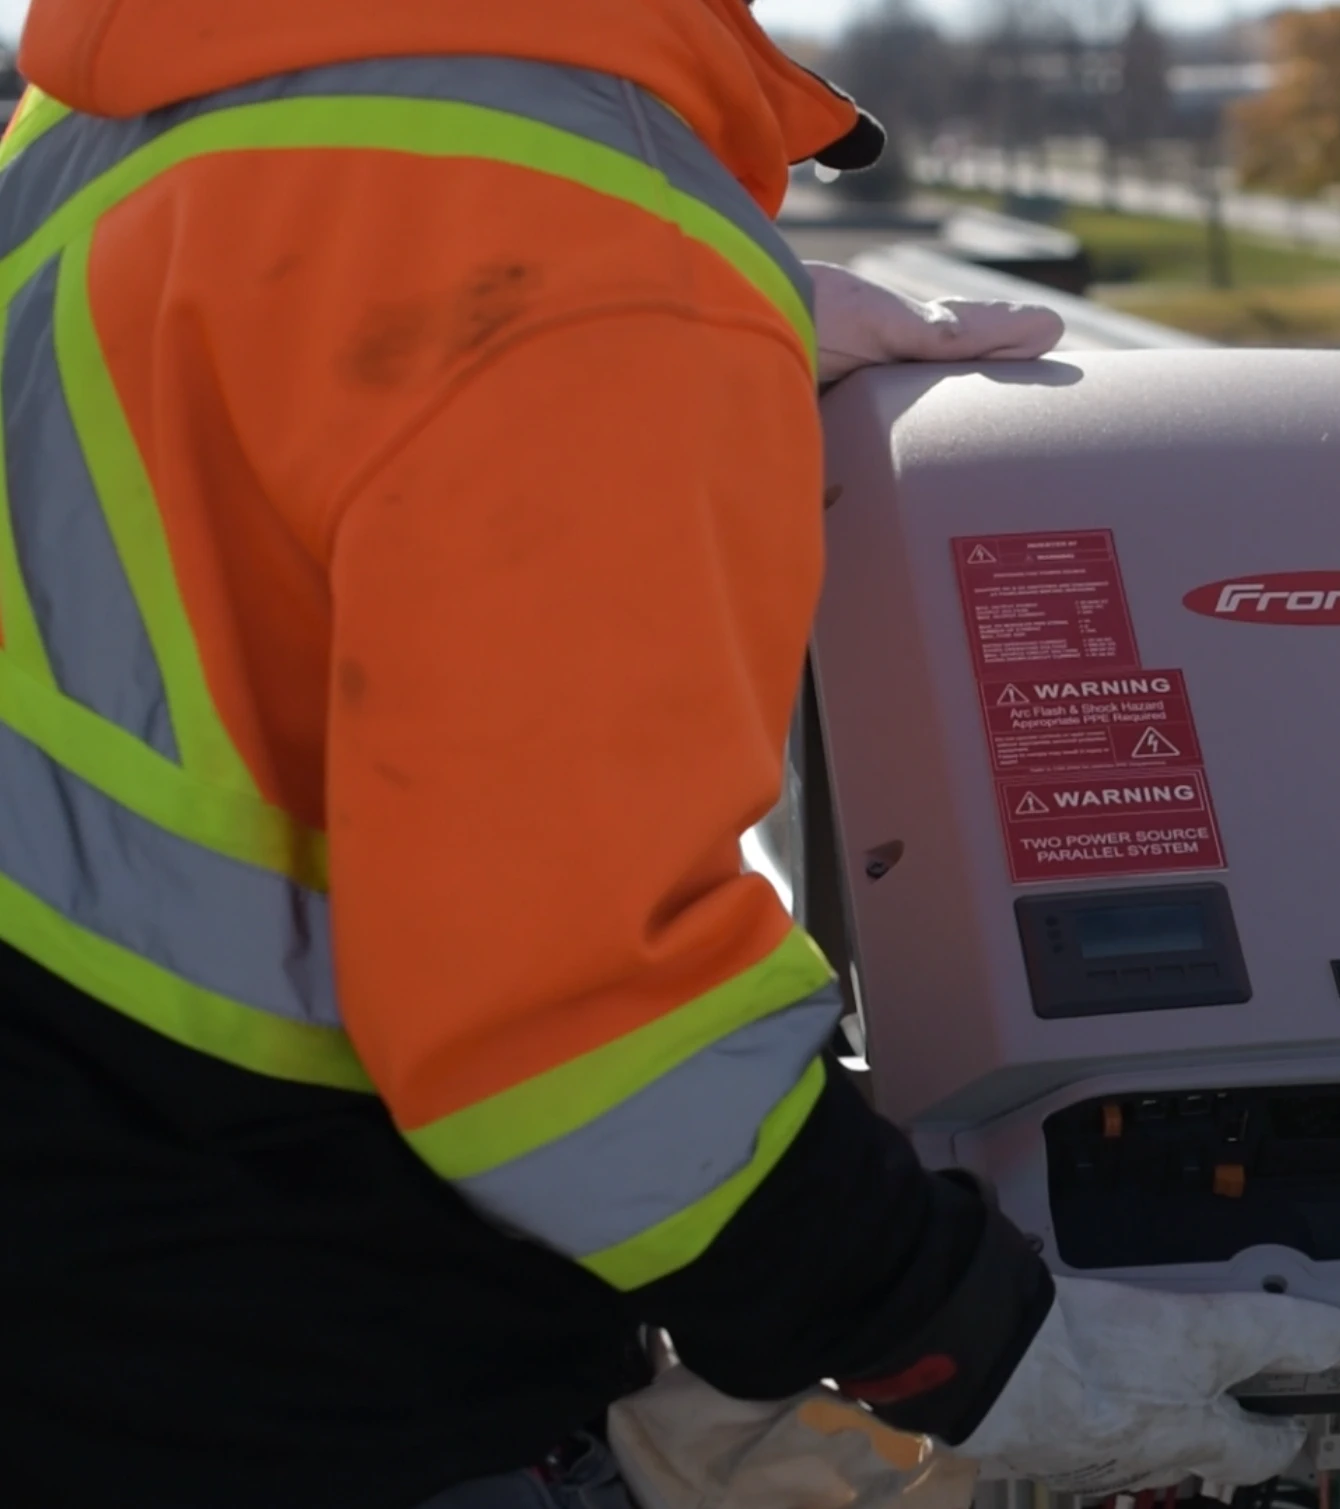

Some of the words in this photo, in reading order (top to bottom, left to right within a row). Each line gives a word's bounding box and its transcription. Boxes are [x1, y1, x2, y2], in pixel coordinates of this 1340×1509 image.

[1034, 678, 1171, 699] WARNING
[1010, 707, 1031, 718] Arc
[1034, 705, 1066, 717] Flash
[1069, 703, 1079, 715] &
[1081, 701, 1118, 714] Shock
[1121, 700, 1164, 712] Hazard
[1012, 717, 1080, 730] Appropriate
[1083, 714, 1110, 724] PPE
[1113, 711, 1167, 724] Required
[1053, 785, 1194, 808] WARNING
[1020, 837, 1061, 850] TWO
[1066, 832, 1131, 847] POWER
[1136, 827, 1209, 842] SOURCE
[1037, 847, 1124, 863] PARALLEL
[1128, 841, 1199, 857] SYSTEM
